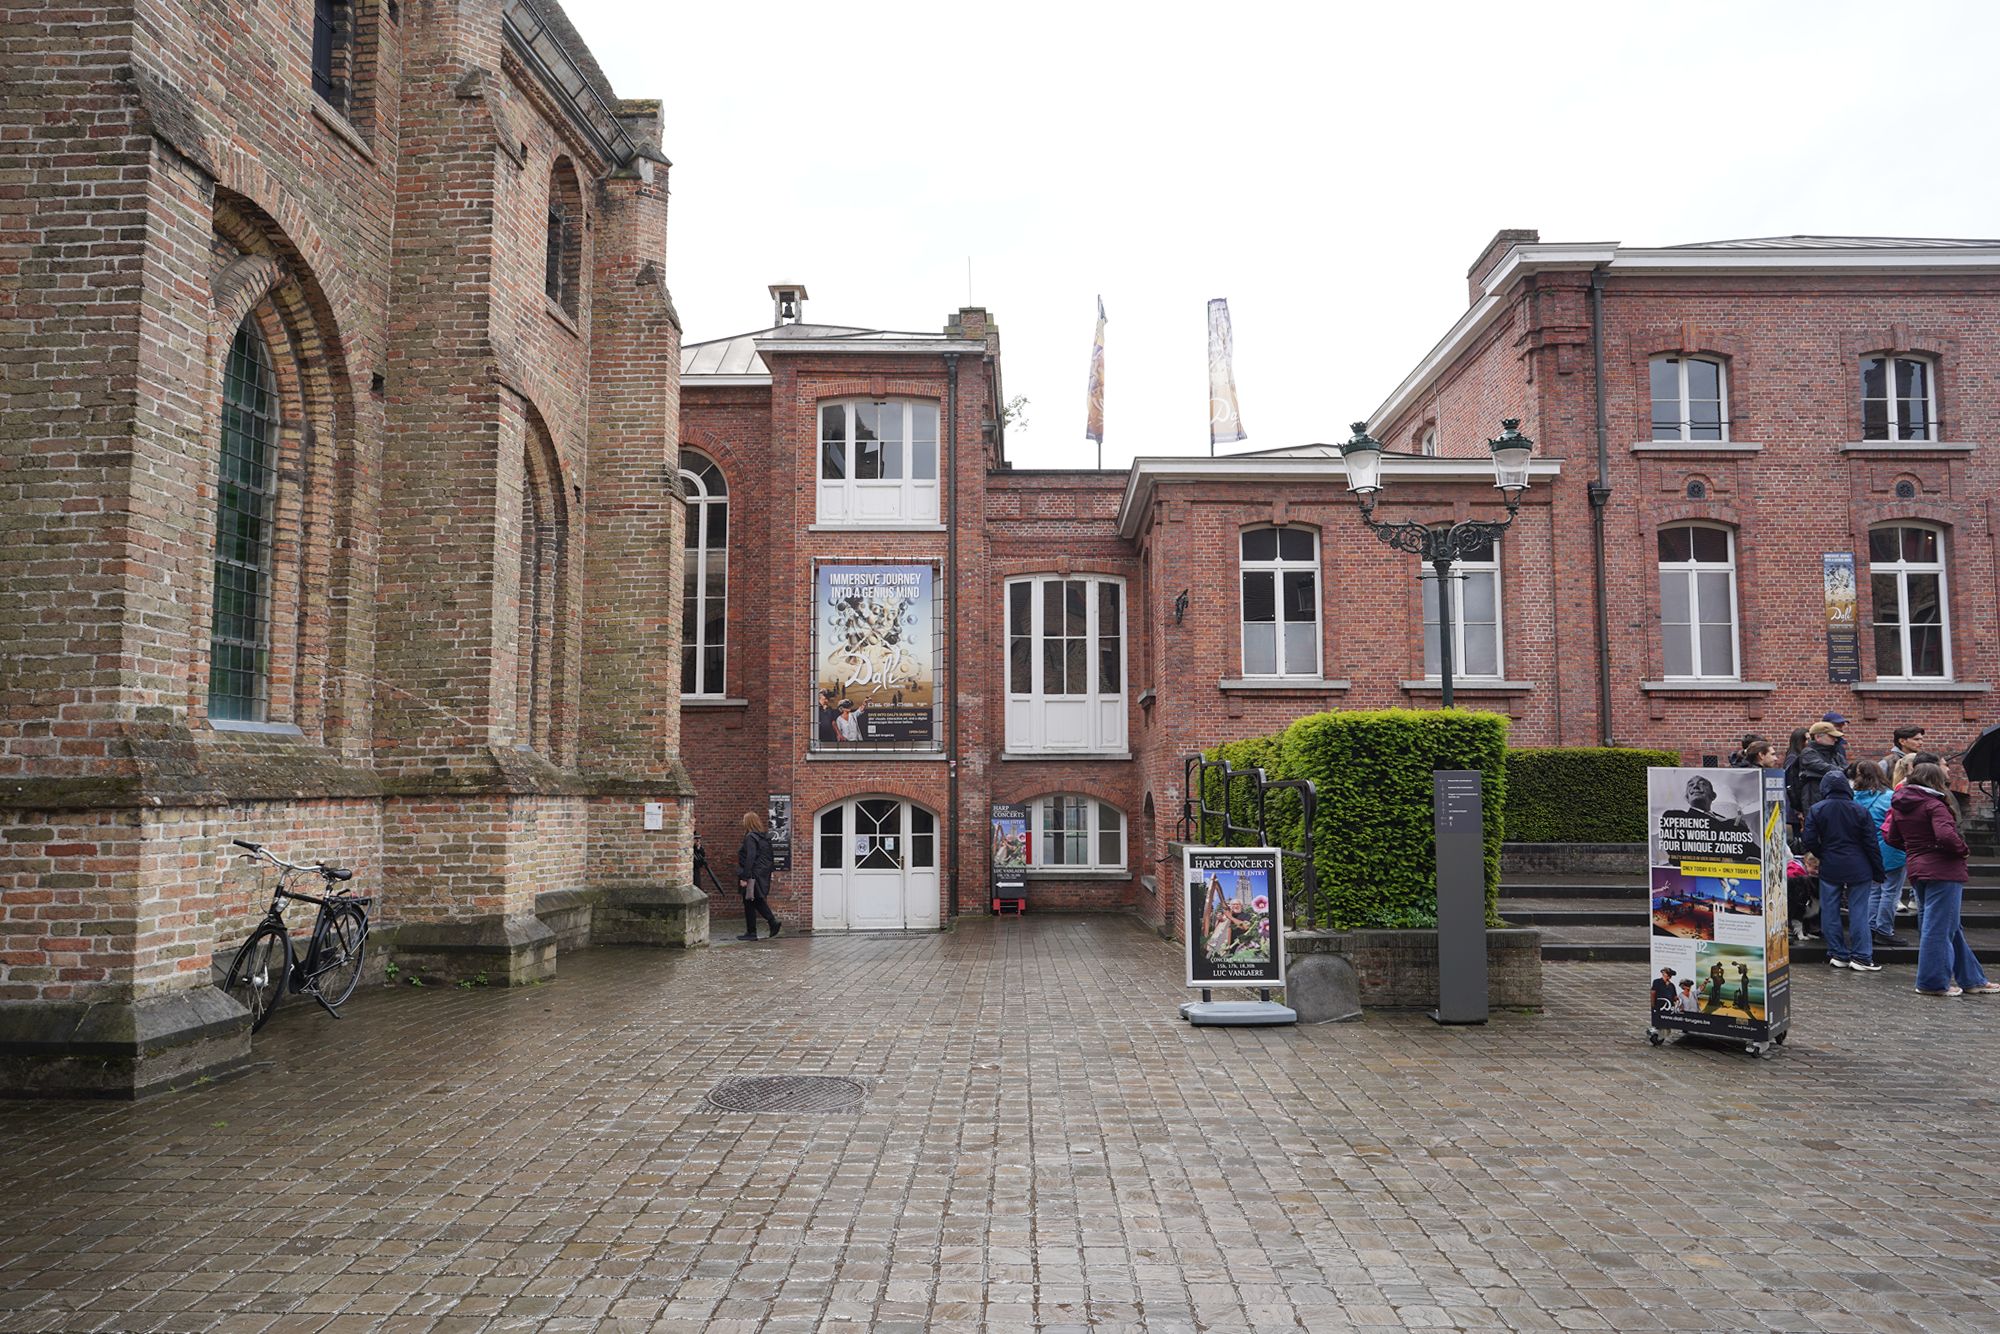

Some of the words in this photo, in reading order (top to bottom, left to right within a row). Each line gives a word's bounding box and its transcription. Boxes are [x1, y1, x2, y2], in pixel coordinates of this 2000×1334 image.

[830, 573, 880, 585] IMMERSIVE
[882, 573, 921, 585] JOURNEY
[831, 586, 853, 598] INTO
[853, 586, 860, 598] A
[861, 586, 894, 598] GENIUS
[896, 586, 920, 598] MIND
[1659, 816, 1710, 829] EXPERIENCE
[1686, 830, 1717, 841] WORLD
[1718, 831, 1753, 843] ACROSS
[1659, 840, 1681, 851] FOUR
[1681, 841, 1713, 853] UNIQUE
[1714, 843, 1744, 854] ZONES
[1195, 859, 1221, 869] HARP
[1223, 859, 1274, 869] CONCERTS
